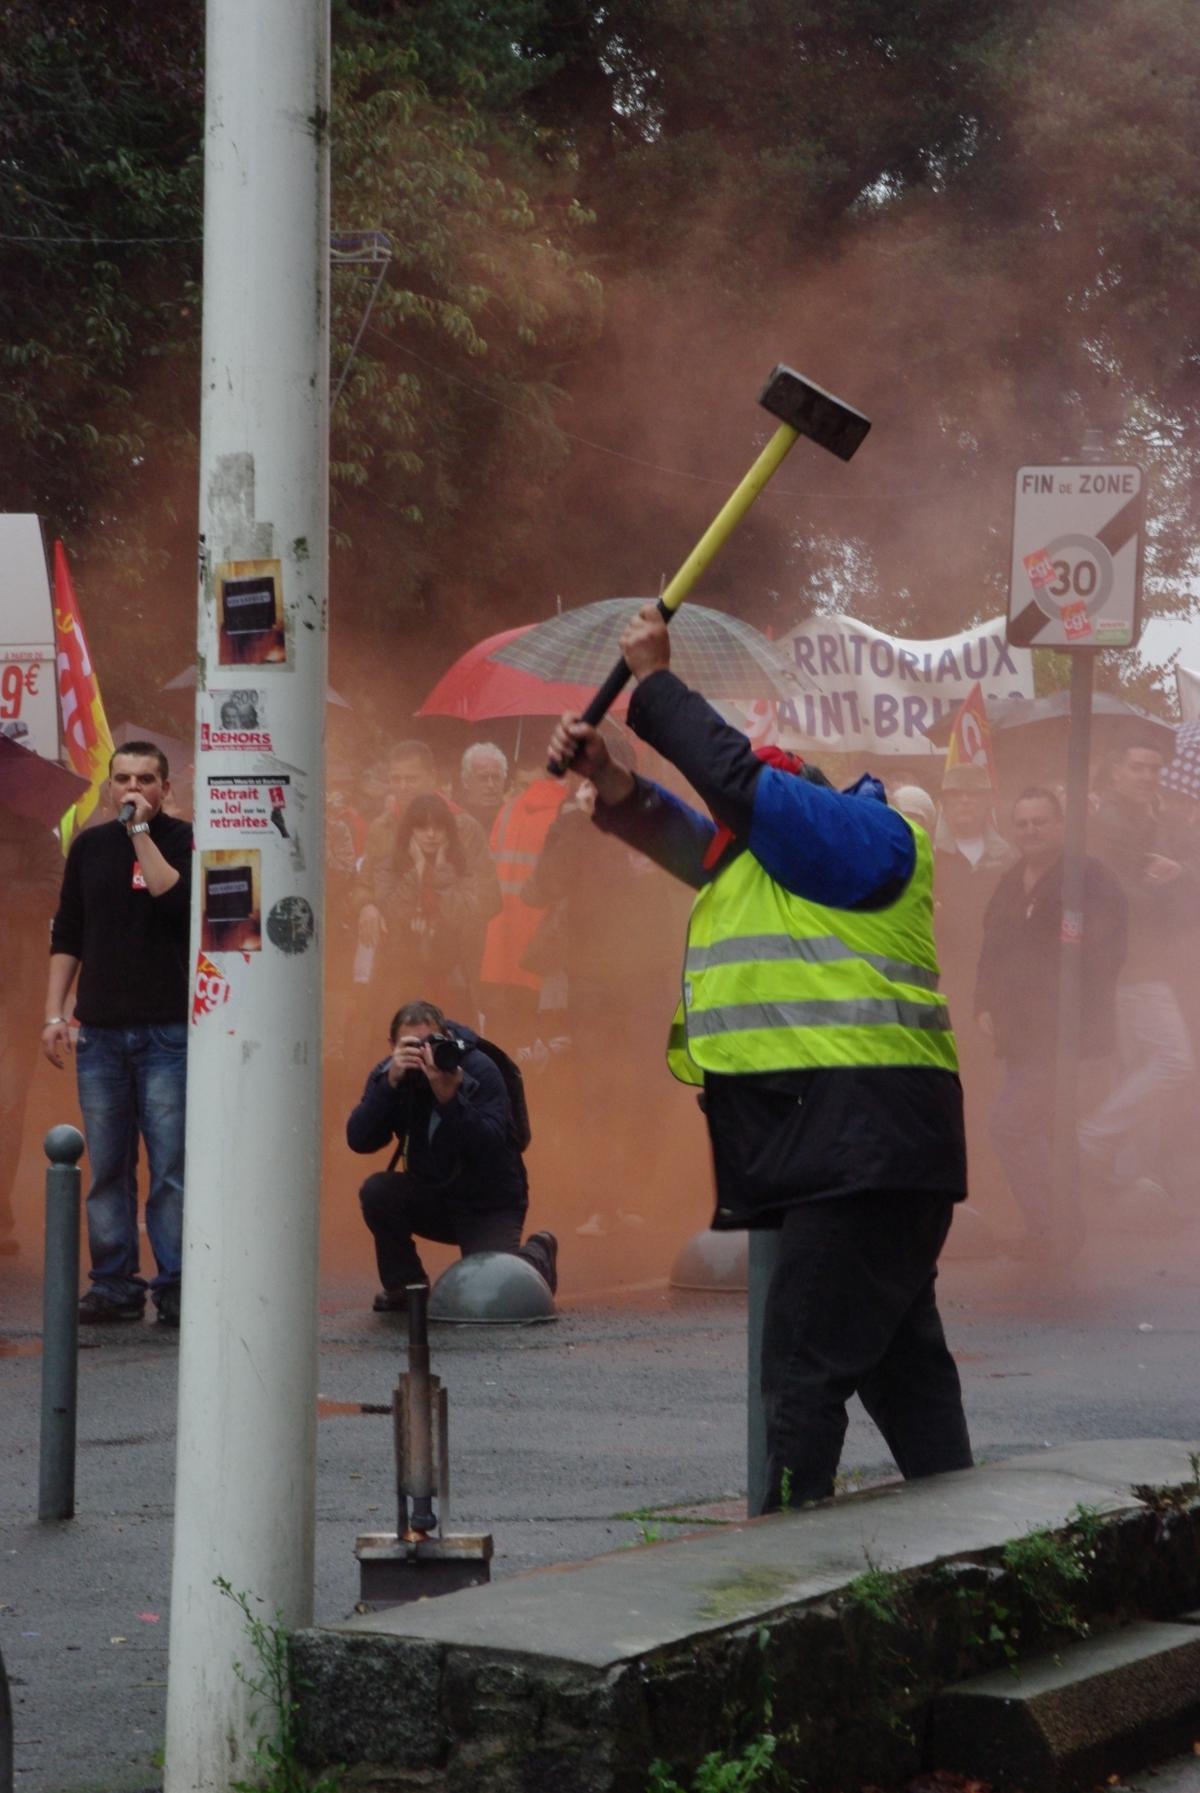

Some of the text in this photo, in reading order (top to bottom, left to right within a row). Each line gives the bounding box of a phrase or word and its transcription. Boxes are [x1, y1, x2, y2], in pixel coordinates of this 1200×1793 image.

[1022, 475, 1134, 494] FIN DE ZONE
[1049, 560, 1097, 596] 30
[211, 732, 271, 744] DEHORS
[210, 787, 259, 800] Retrait
[224, 801, 242, 814] loi
[210, 815, 269, 828] retraites
